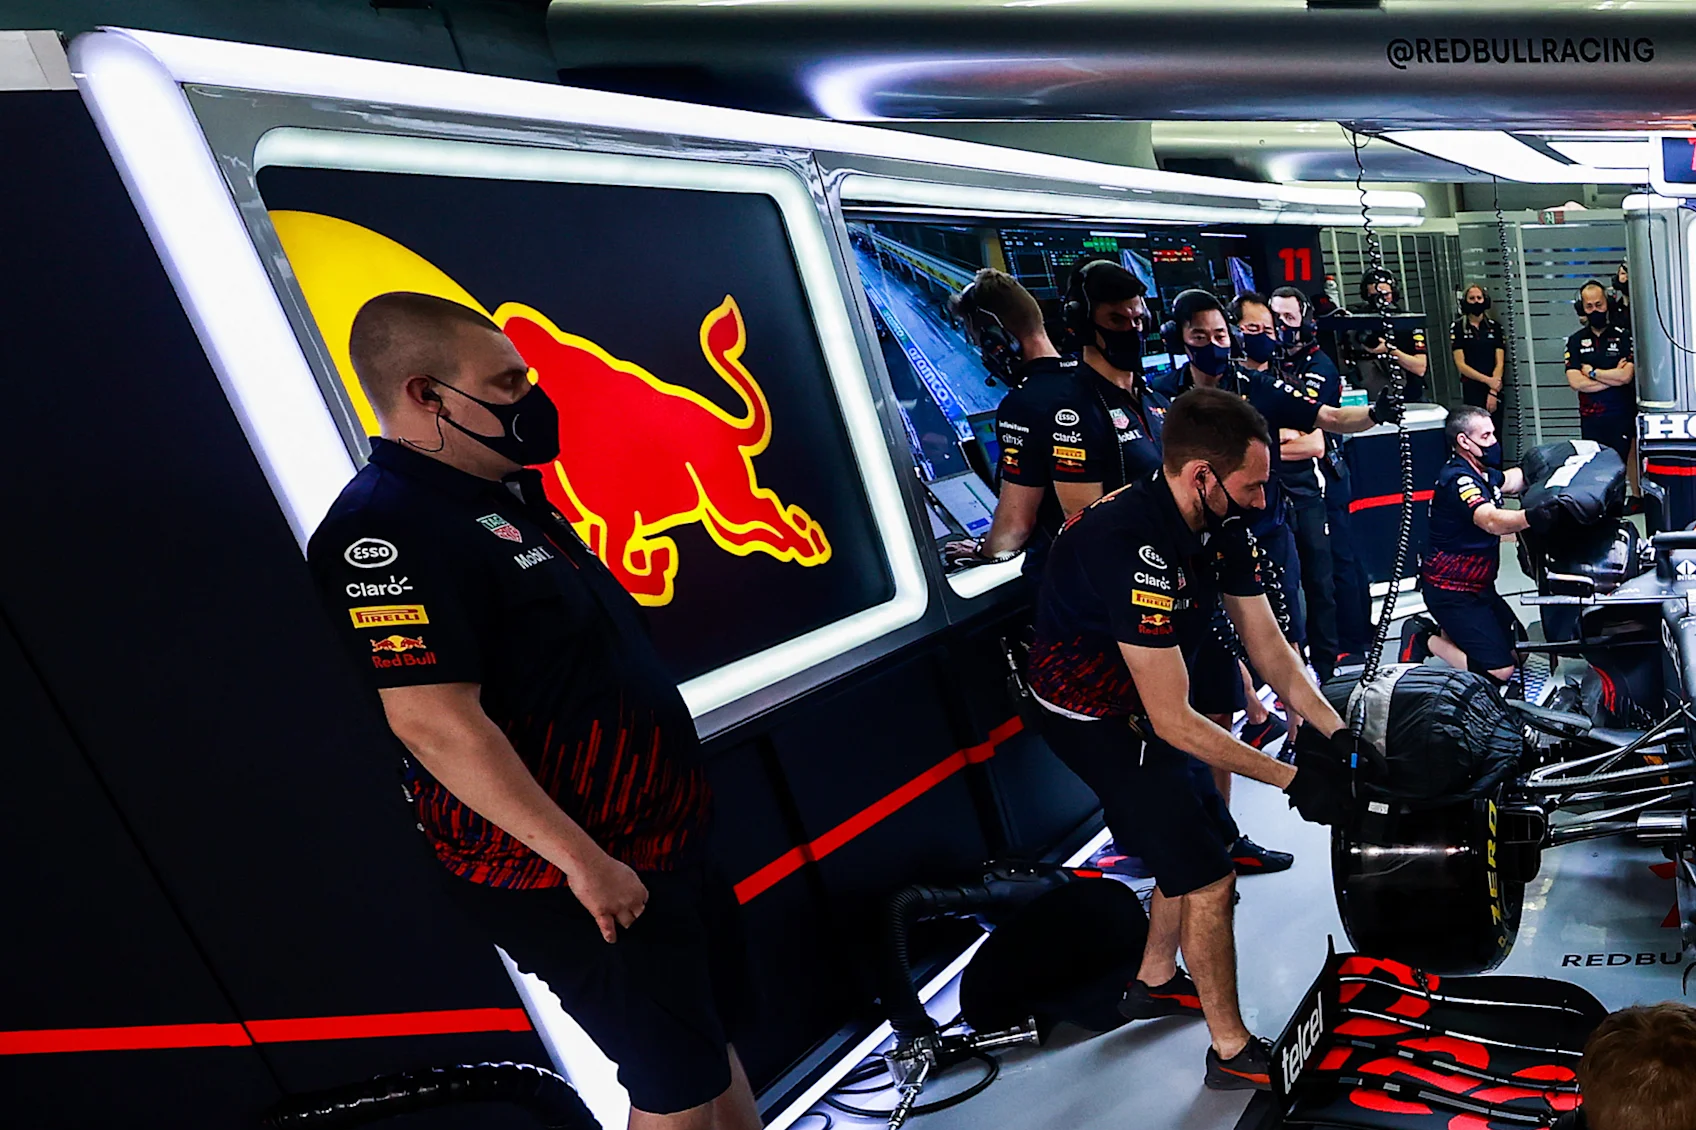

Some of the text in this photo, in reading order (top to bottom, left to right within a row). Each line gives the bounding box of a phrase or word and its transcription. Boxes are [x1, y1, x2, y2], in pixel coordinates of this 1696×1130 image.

[1386, 37, 1655, 69] @REDBULLRACING
[1278, 248, 1312, 281] 11
[907, 346, 951, 402] aramco
[1053, 433, 1079, 444] Claro
[514, 548, 546, 570] Mobil
[346, 577, 406, 598] Claro
[1134, 572, 1169, 590] Claro
[1136, 593, 1172, 610] PIRELLI
[356, 608, 420, 624] PIRELLI
[372, 651, 437, 669] Red Bull
[1281, 993, 1323, 1096] telcel
